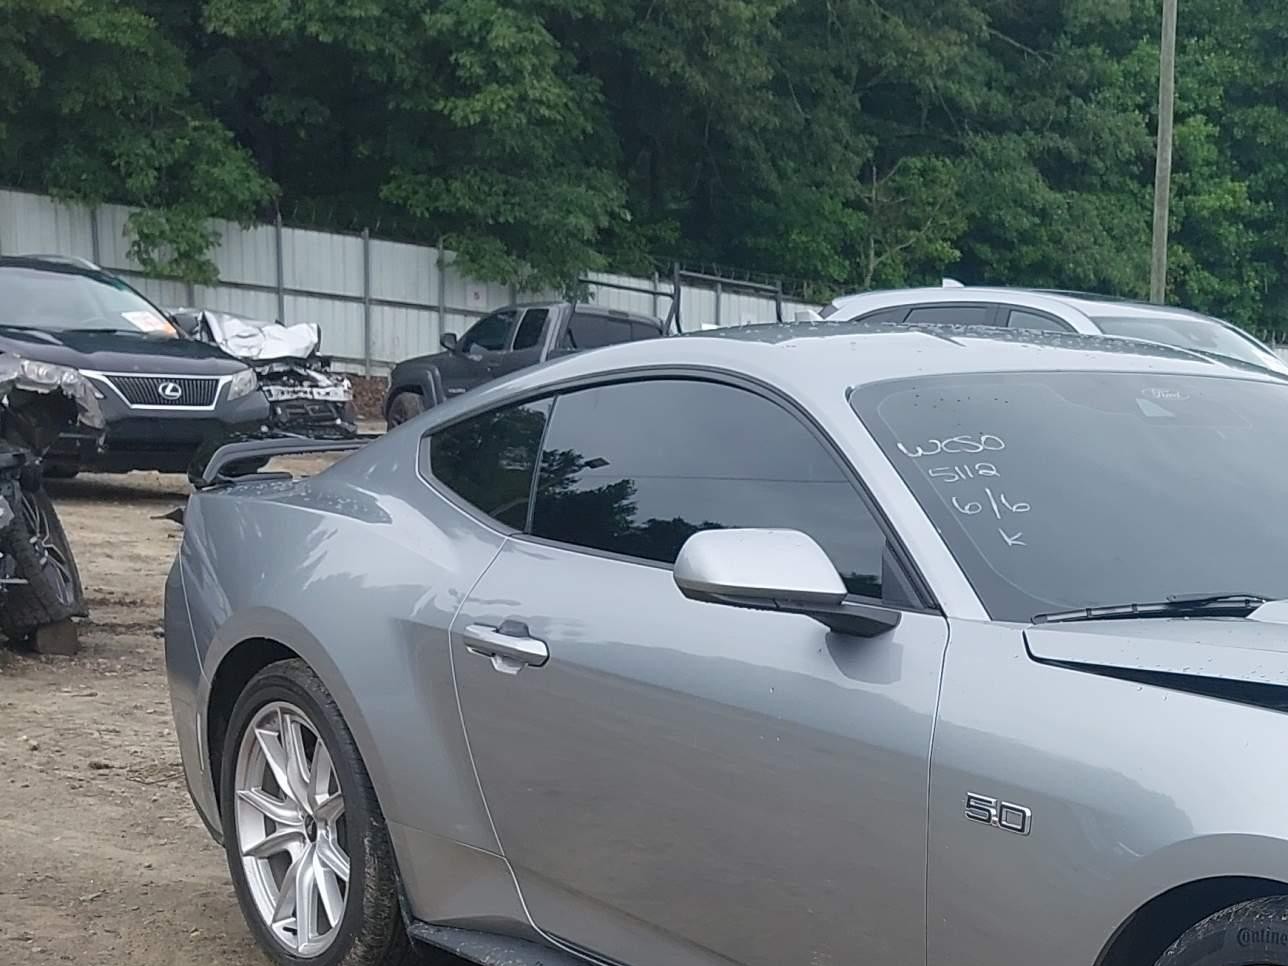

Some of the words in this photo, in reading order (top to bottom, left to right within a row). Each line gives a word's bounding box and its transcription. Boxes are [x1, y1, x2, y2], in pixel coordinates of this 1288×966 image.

[928, 462, 1001, 482] 5112
[952, 488, 1031, 519] 6/6
[965, 791, 1032, 835] 5.0
